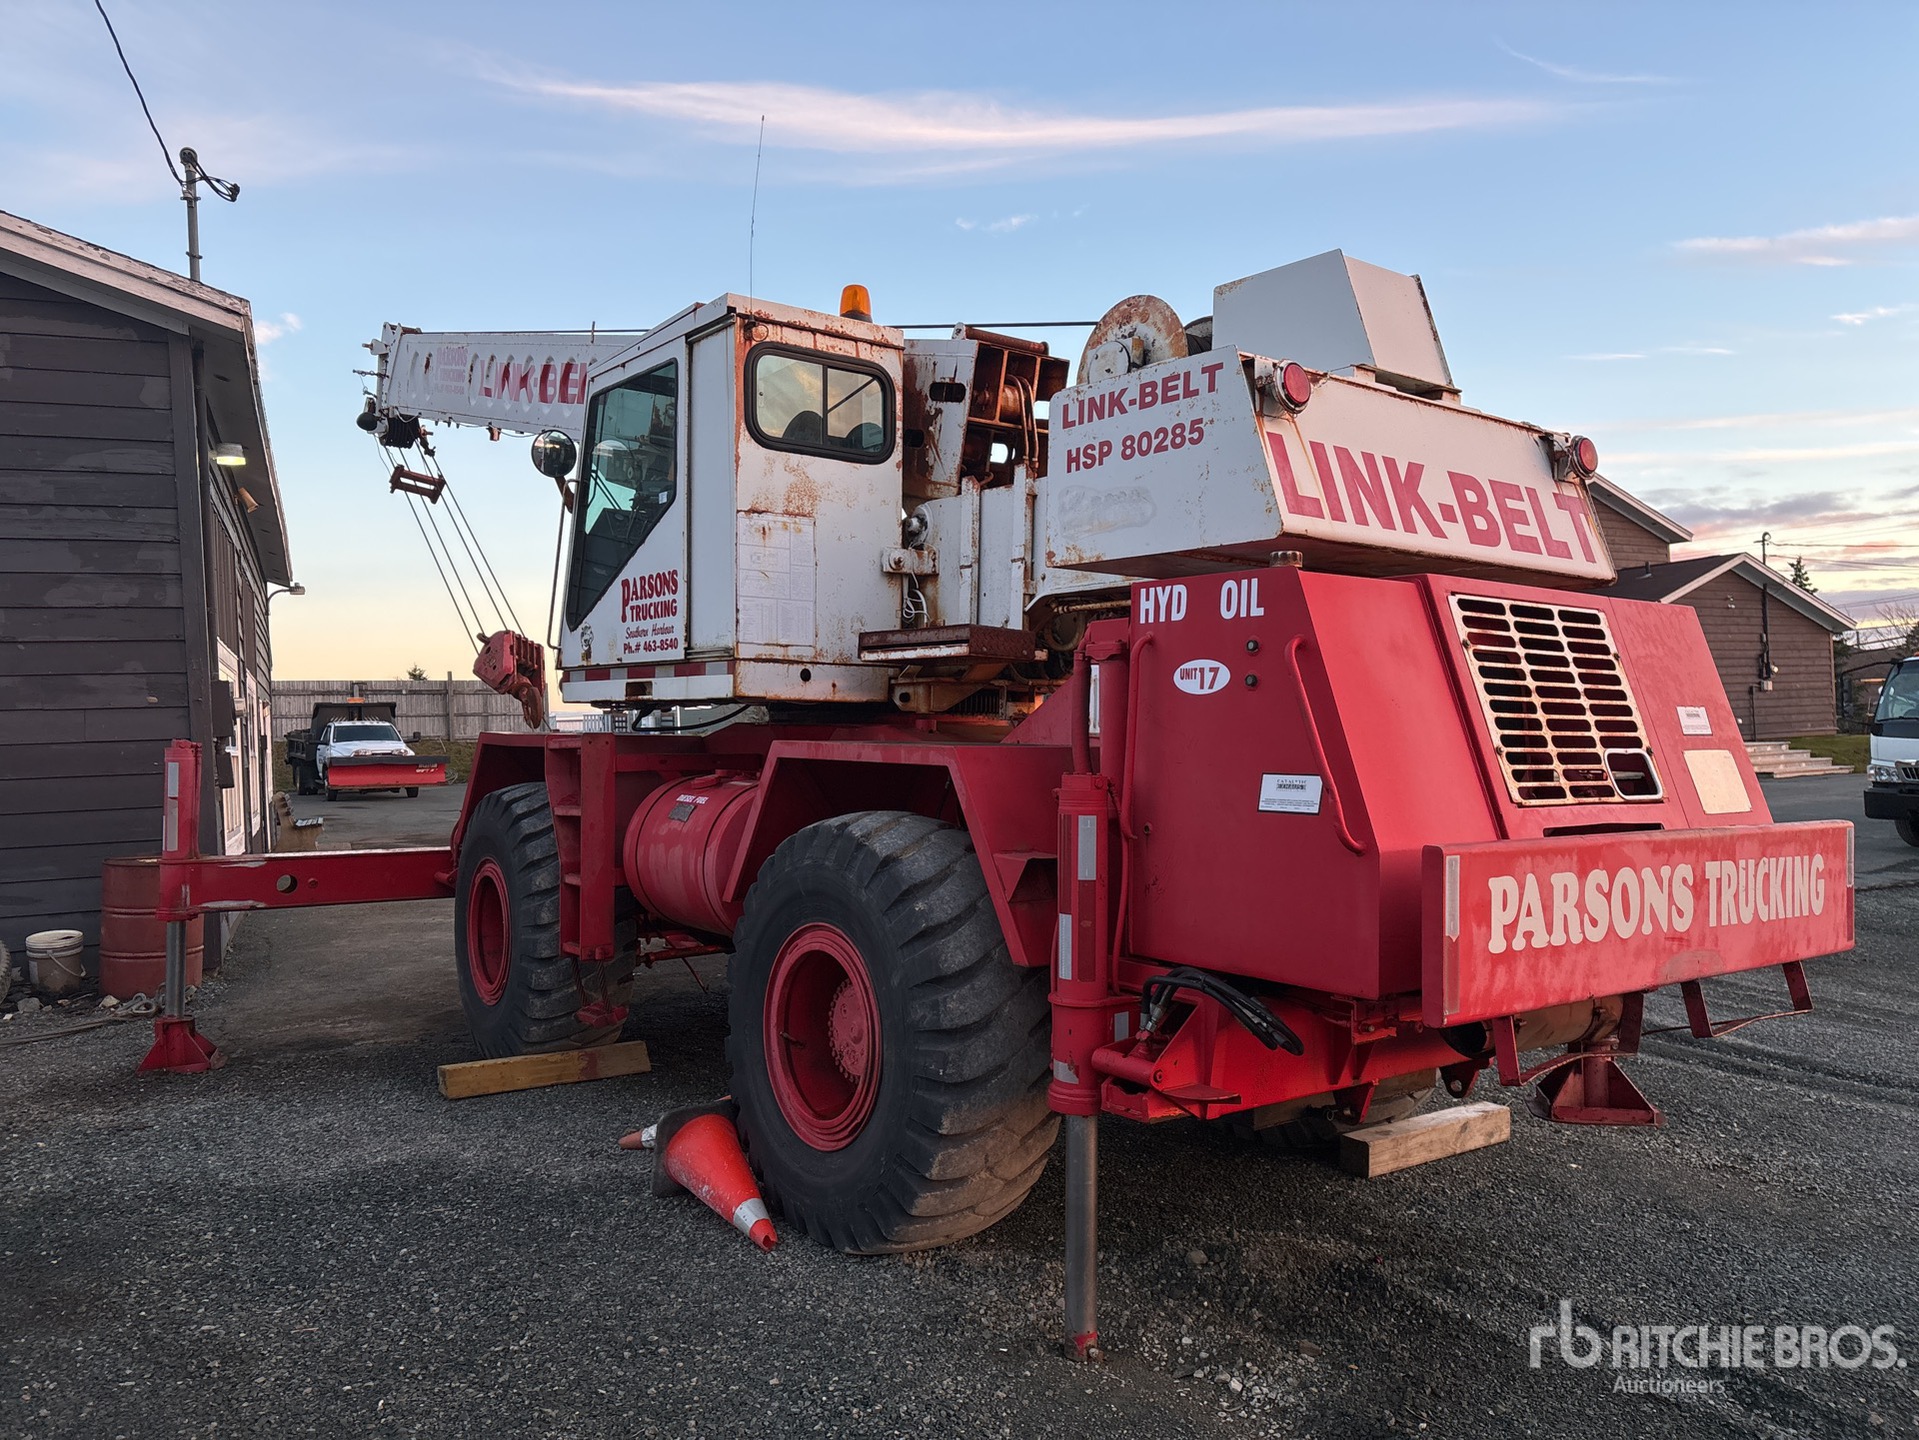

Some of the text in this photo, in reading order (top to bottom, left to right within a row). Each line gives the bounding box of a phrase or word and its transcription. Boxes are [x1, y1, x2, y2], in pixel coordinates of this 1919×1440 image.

[1062, 362, 1225, 430] LINK-BELT
[1066, 418, 1206, 474] HSP 80285
[1267, 431, 1597, 564] LINK-BELT
[621, 569, 678, 623] PARSONS
[630, 599, 678, 622] TRUCKING
[1139, 577, 1265, 624] HYD OIL
[643, 637, 679, 653] 463-8540
[1180, 666, 1220, 690] UNIT 17
[1488, 853, 1825, 954] PARSONS TRUCKING
